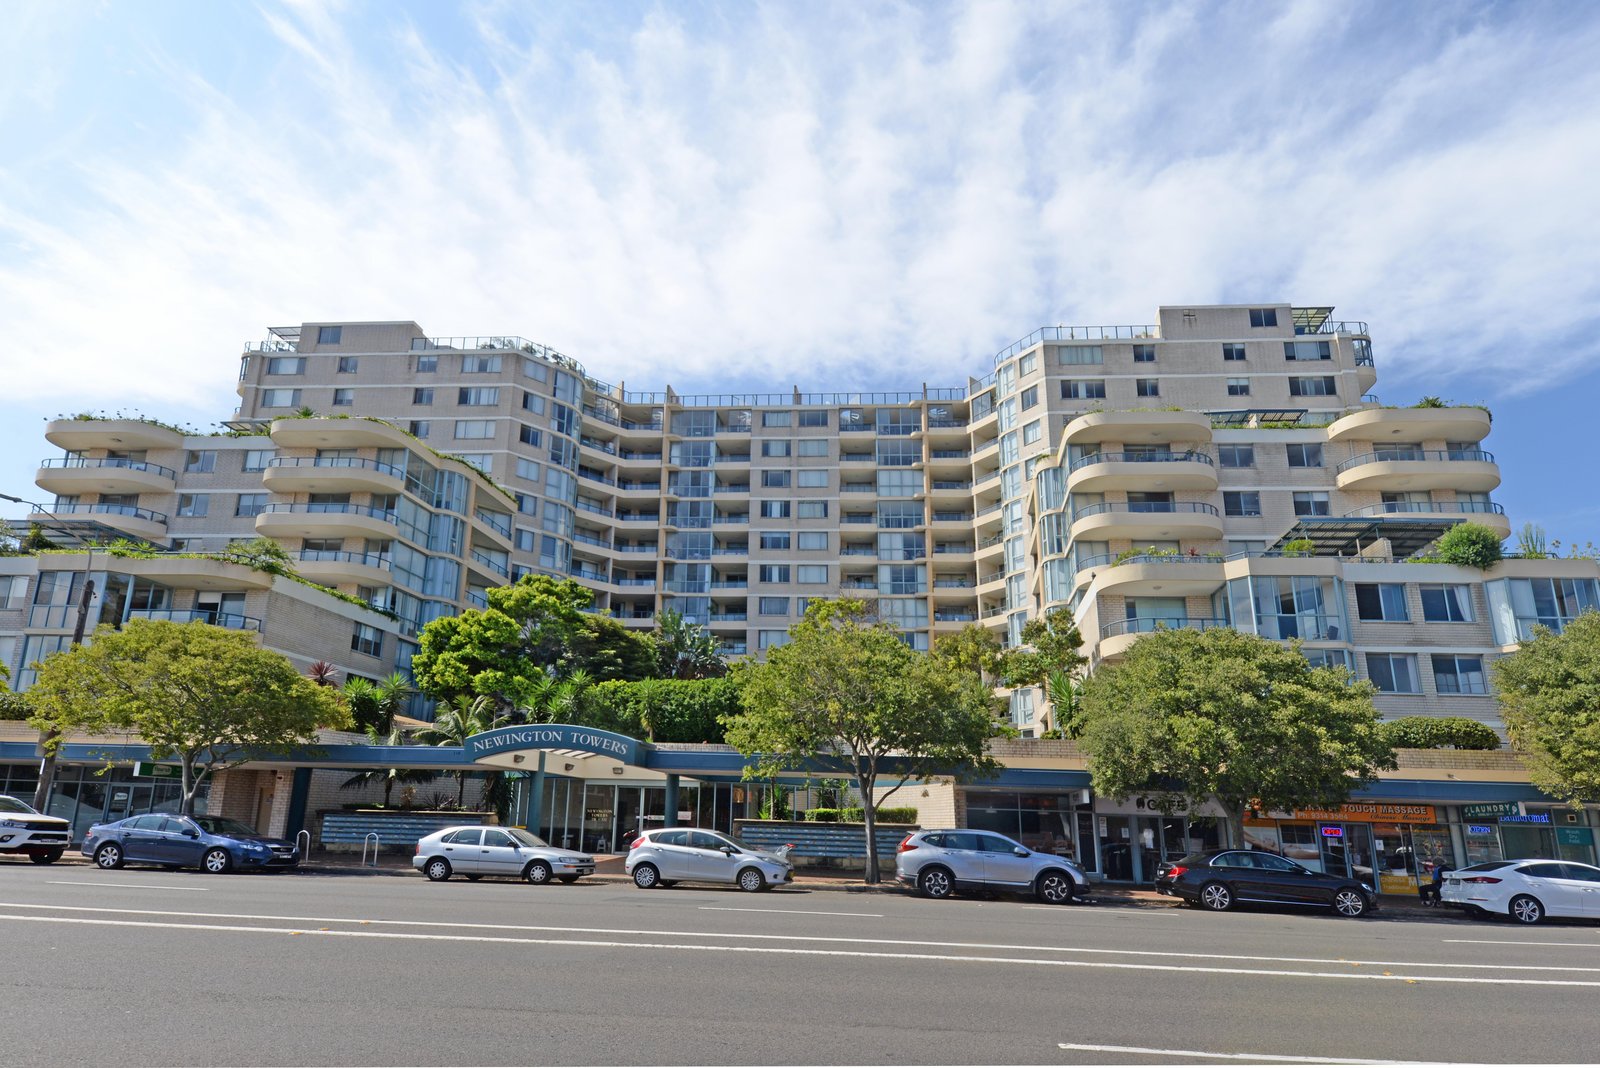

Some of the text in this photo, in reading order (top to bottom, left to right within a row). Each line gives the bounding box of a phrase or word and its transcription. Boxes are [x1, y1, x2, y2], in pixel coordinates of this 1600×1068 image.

[473, 730, 629, 755] NEWINGTON TOWERS
[1343, 804, 1377, 813] TOUCH
[1381, 805, 1427, 815] MASSAGE
[1470, 804, 1510, 813] LAUNDRY
[1469, 825, 1491, 833] OPEN
